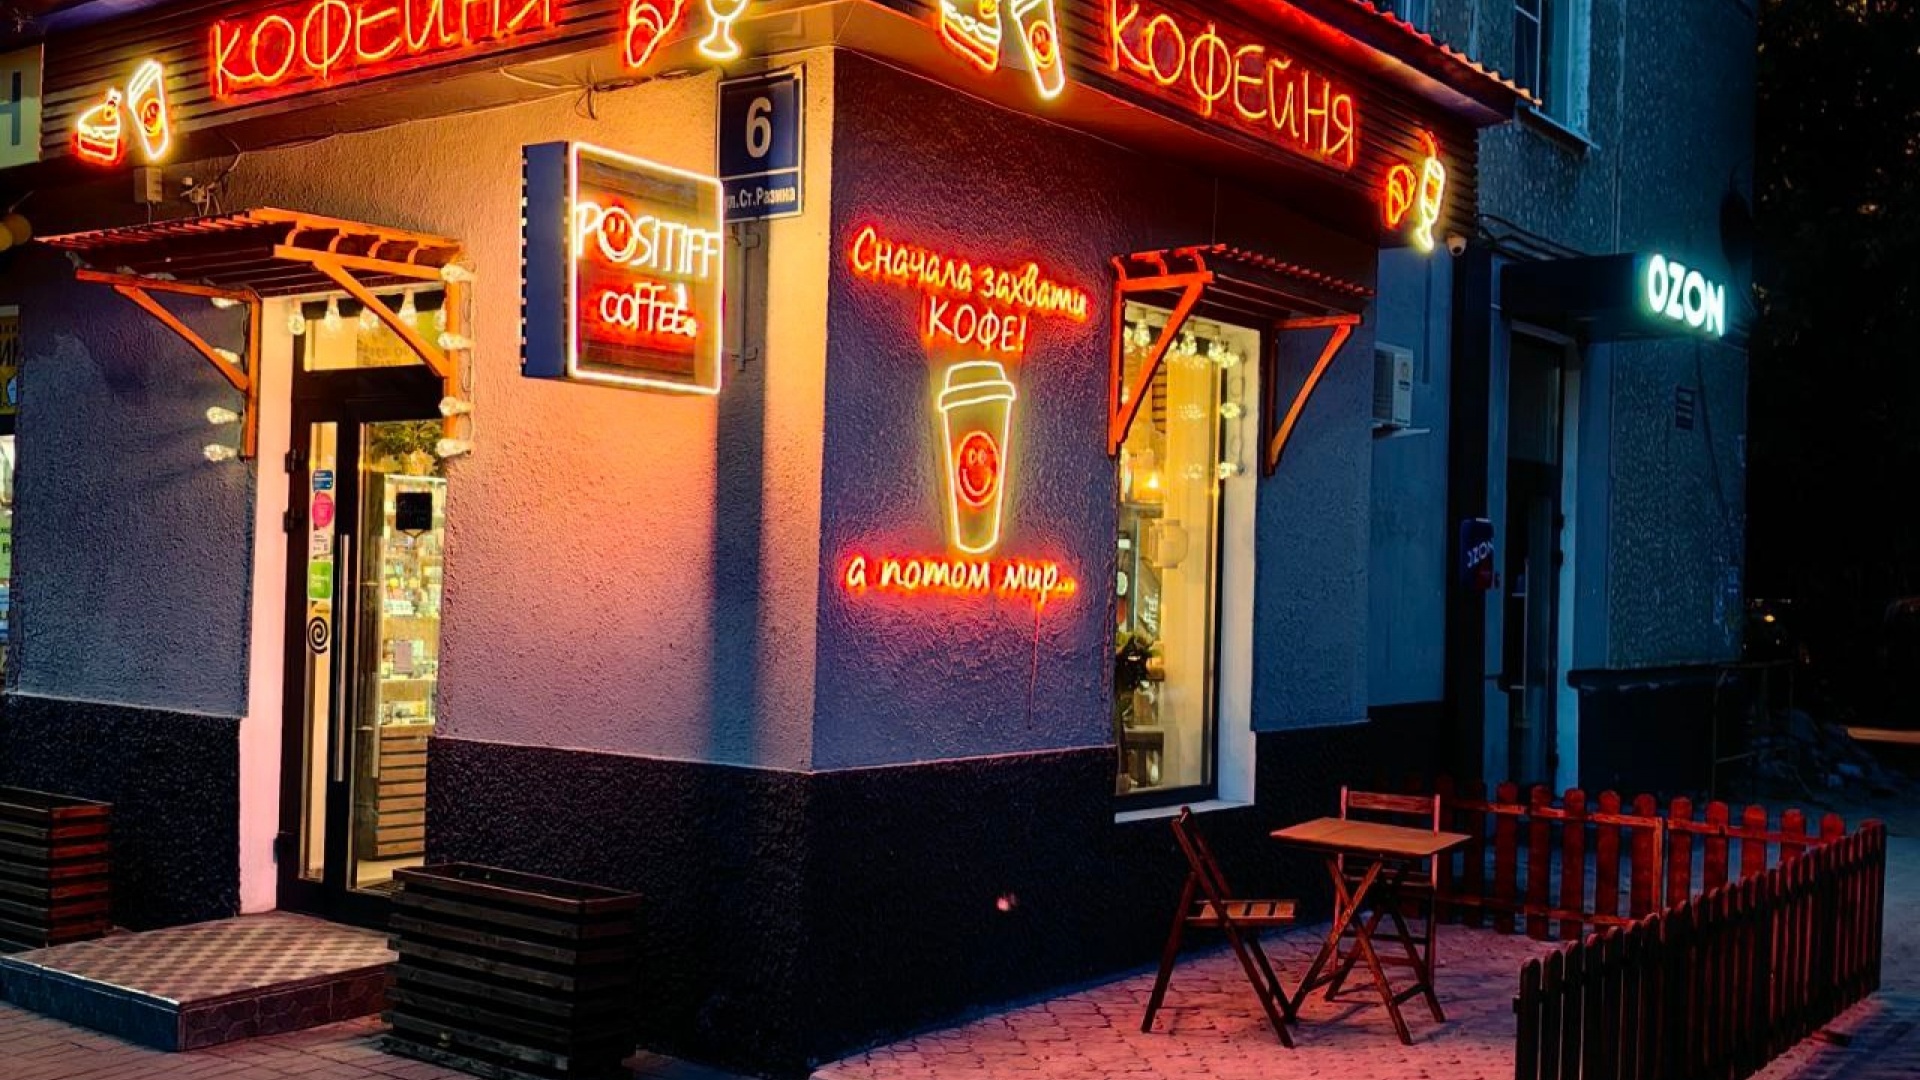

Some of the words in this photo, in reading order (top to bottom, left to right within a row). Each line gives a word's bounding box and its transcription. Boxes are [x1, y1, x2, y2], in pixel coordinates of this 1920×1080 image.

[1106, 0, 1354, 167] КОФЕЙНЯ
[746, 96, 772, 158] 6
[727, 187, 796, 209] л.Ст.Разина
[576, 202, 721, 277] POSITIFF
[853, 226, 972, 292] Сначала
[980, 262, 1087, 316] захвати
[928, 296, 1027, 351] КОФЕ!
[1648, 253, 1725, 337] OZON
[880, 561, 990, 590] потом
